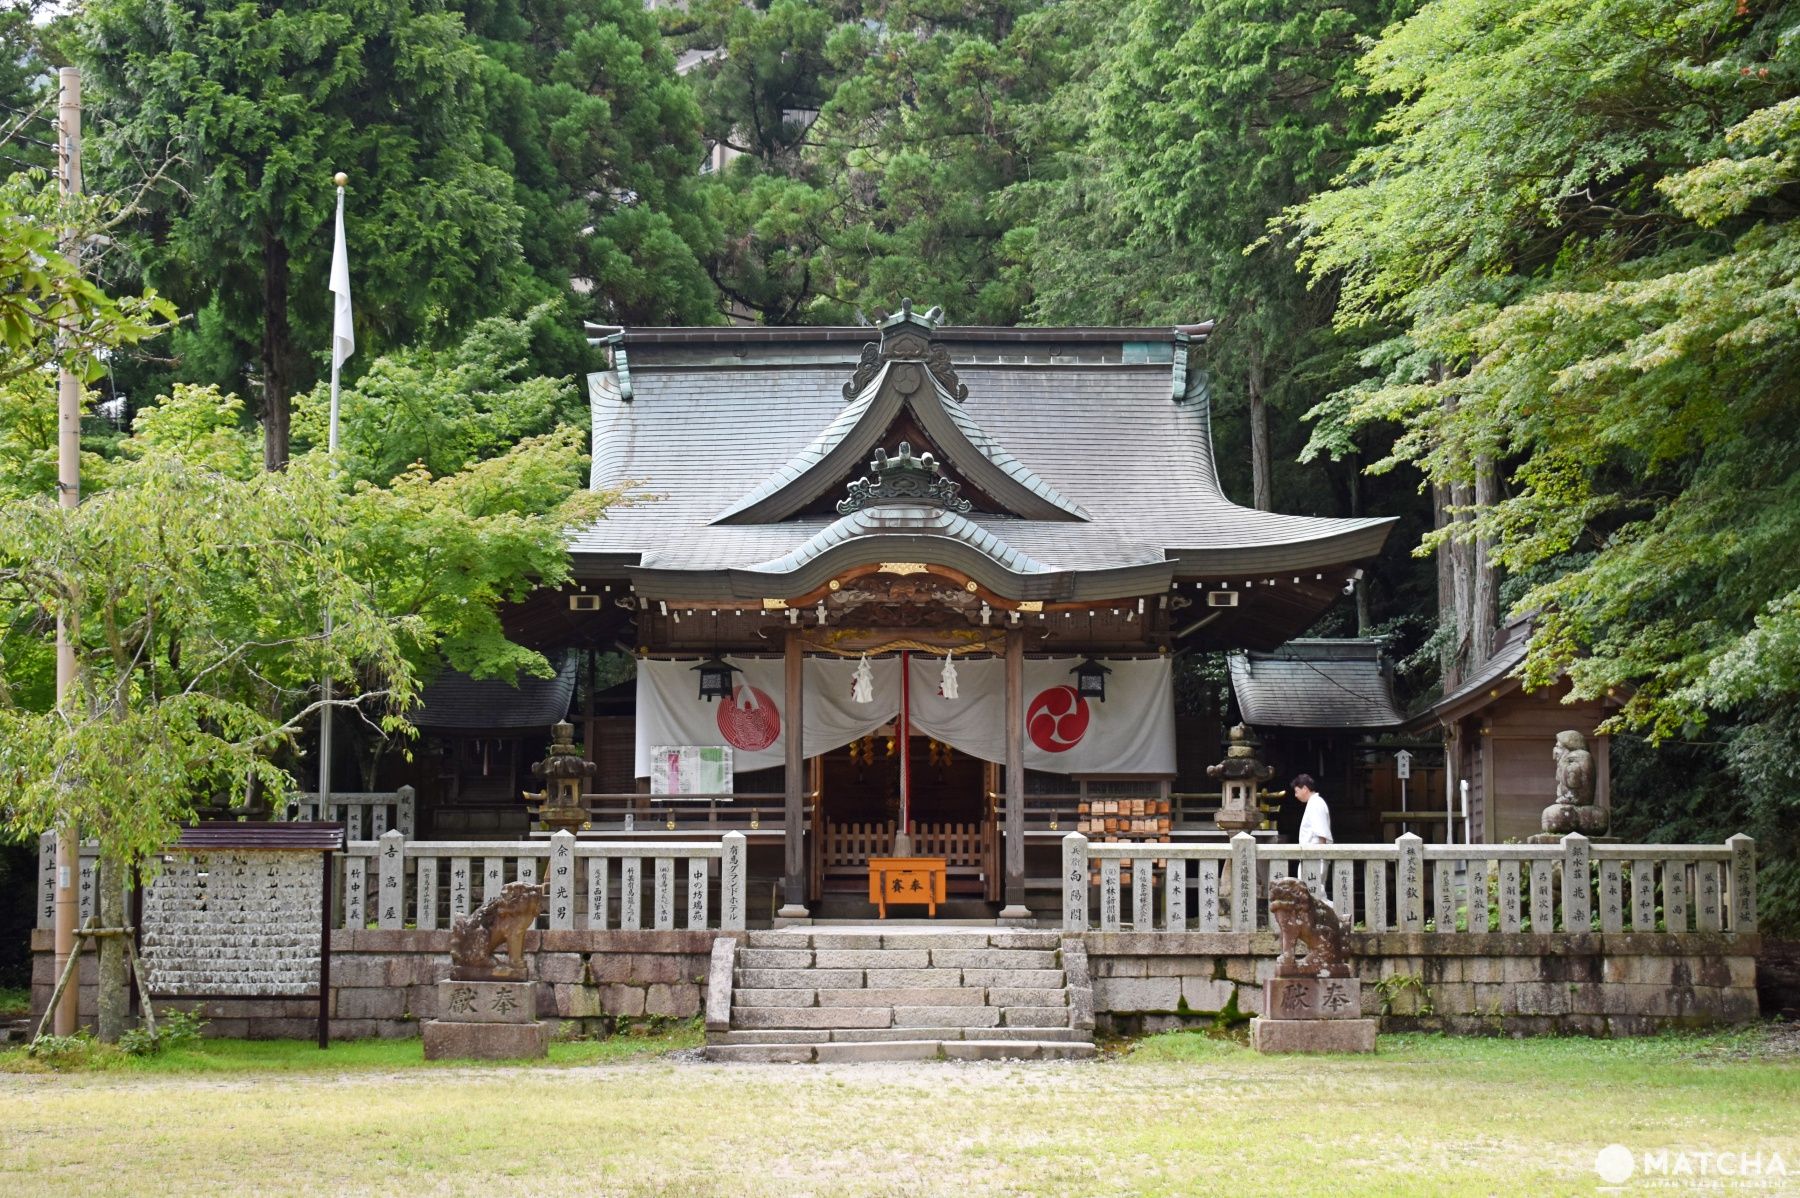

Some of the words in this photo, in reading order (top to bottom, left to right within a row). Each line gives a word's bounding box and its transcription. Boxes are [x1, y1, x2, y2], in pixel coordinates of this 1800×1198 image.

[692, 869, 703, 921] 中の坊瑞苑
[729, 845, 739, 921] 有馬グランドホテル
